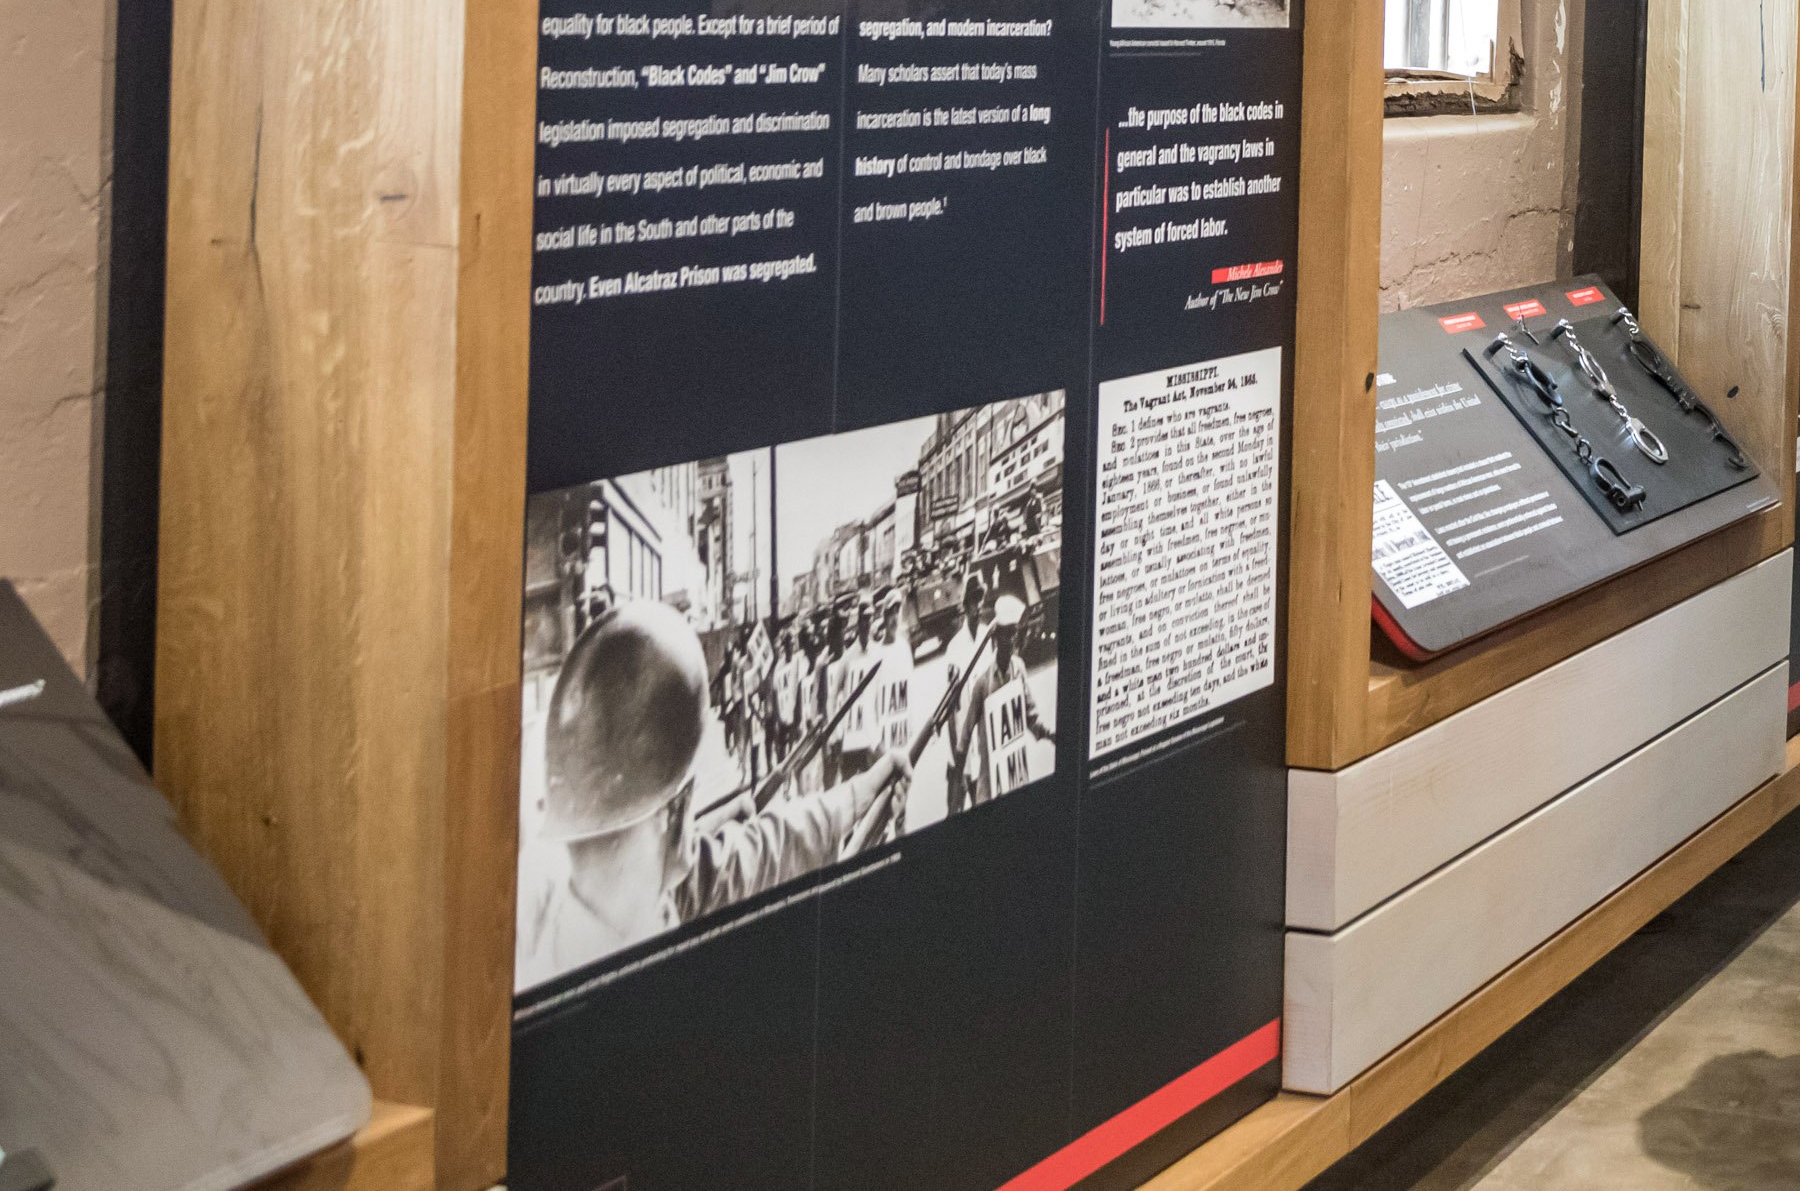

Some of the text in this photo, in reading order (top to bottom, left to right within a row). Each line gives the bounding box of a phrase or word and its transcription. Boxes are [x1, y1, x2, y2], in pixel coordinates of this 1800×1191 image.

[1147, 109, 1188, 130] purpose
[1190, 103, 1200, 124] of
[1202, 104, 1218, 123] the
[1219, 102, 1245, 122] black
[1246, 101, 1273, 120] codes
[1275, 100, 1283, 119] in
[1117, 137, 1274, 172] general and the vagrancy laws in
[1116, 175, 1281, 212] particular was to establish another
[1115, 218, 1228, 252] system of forced labor.
